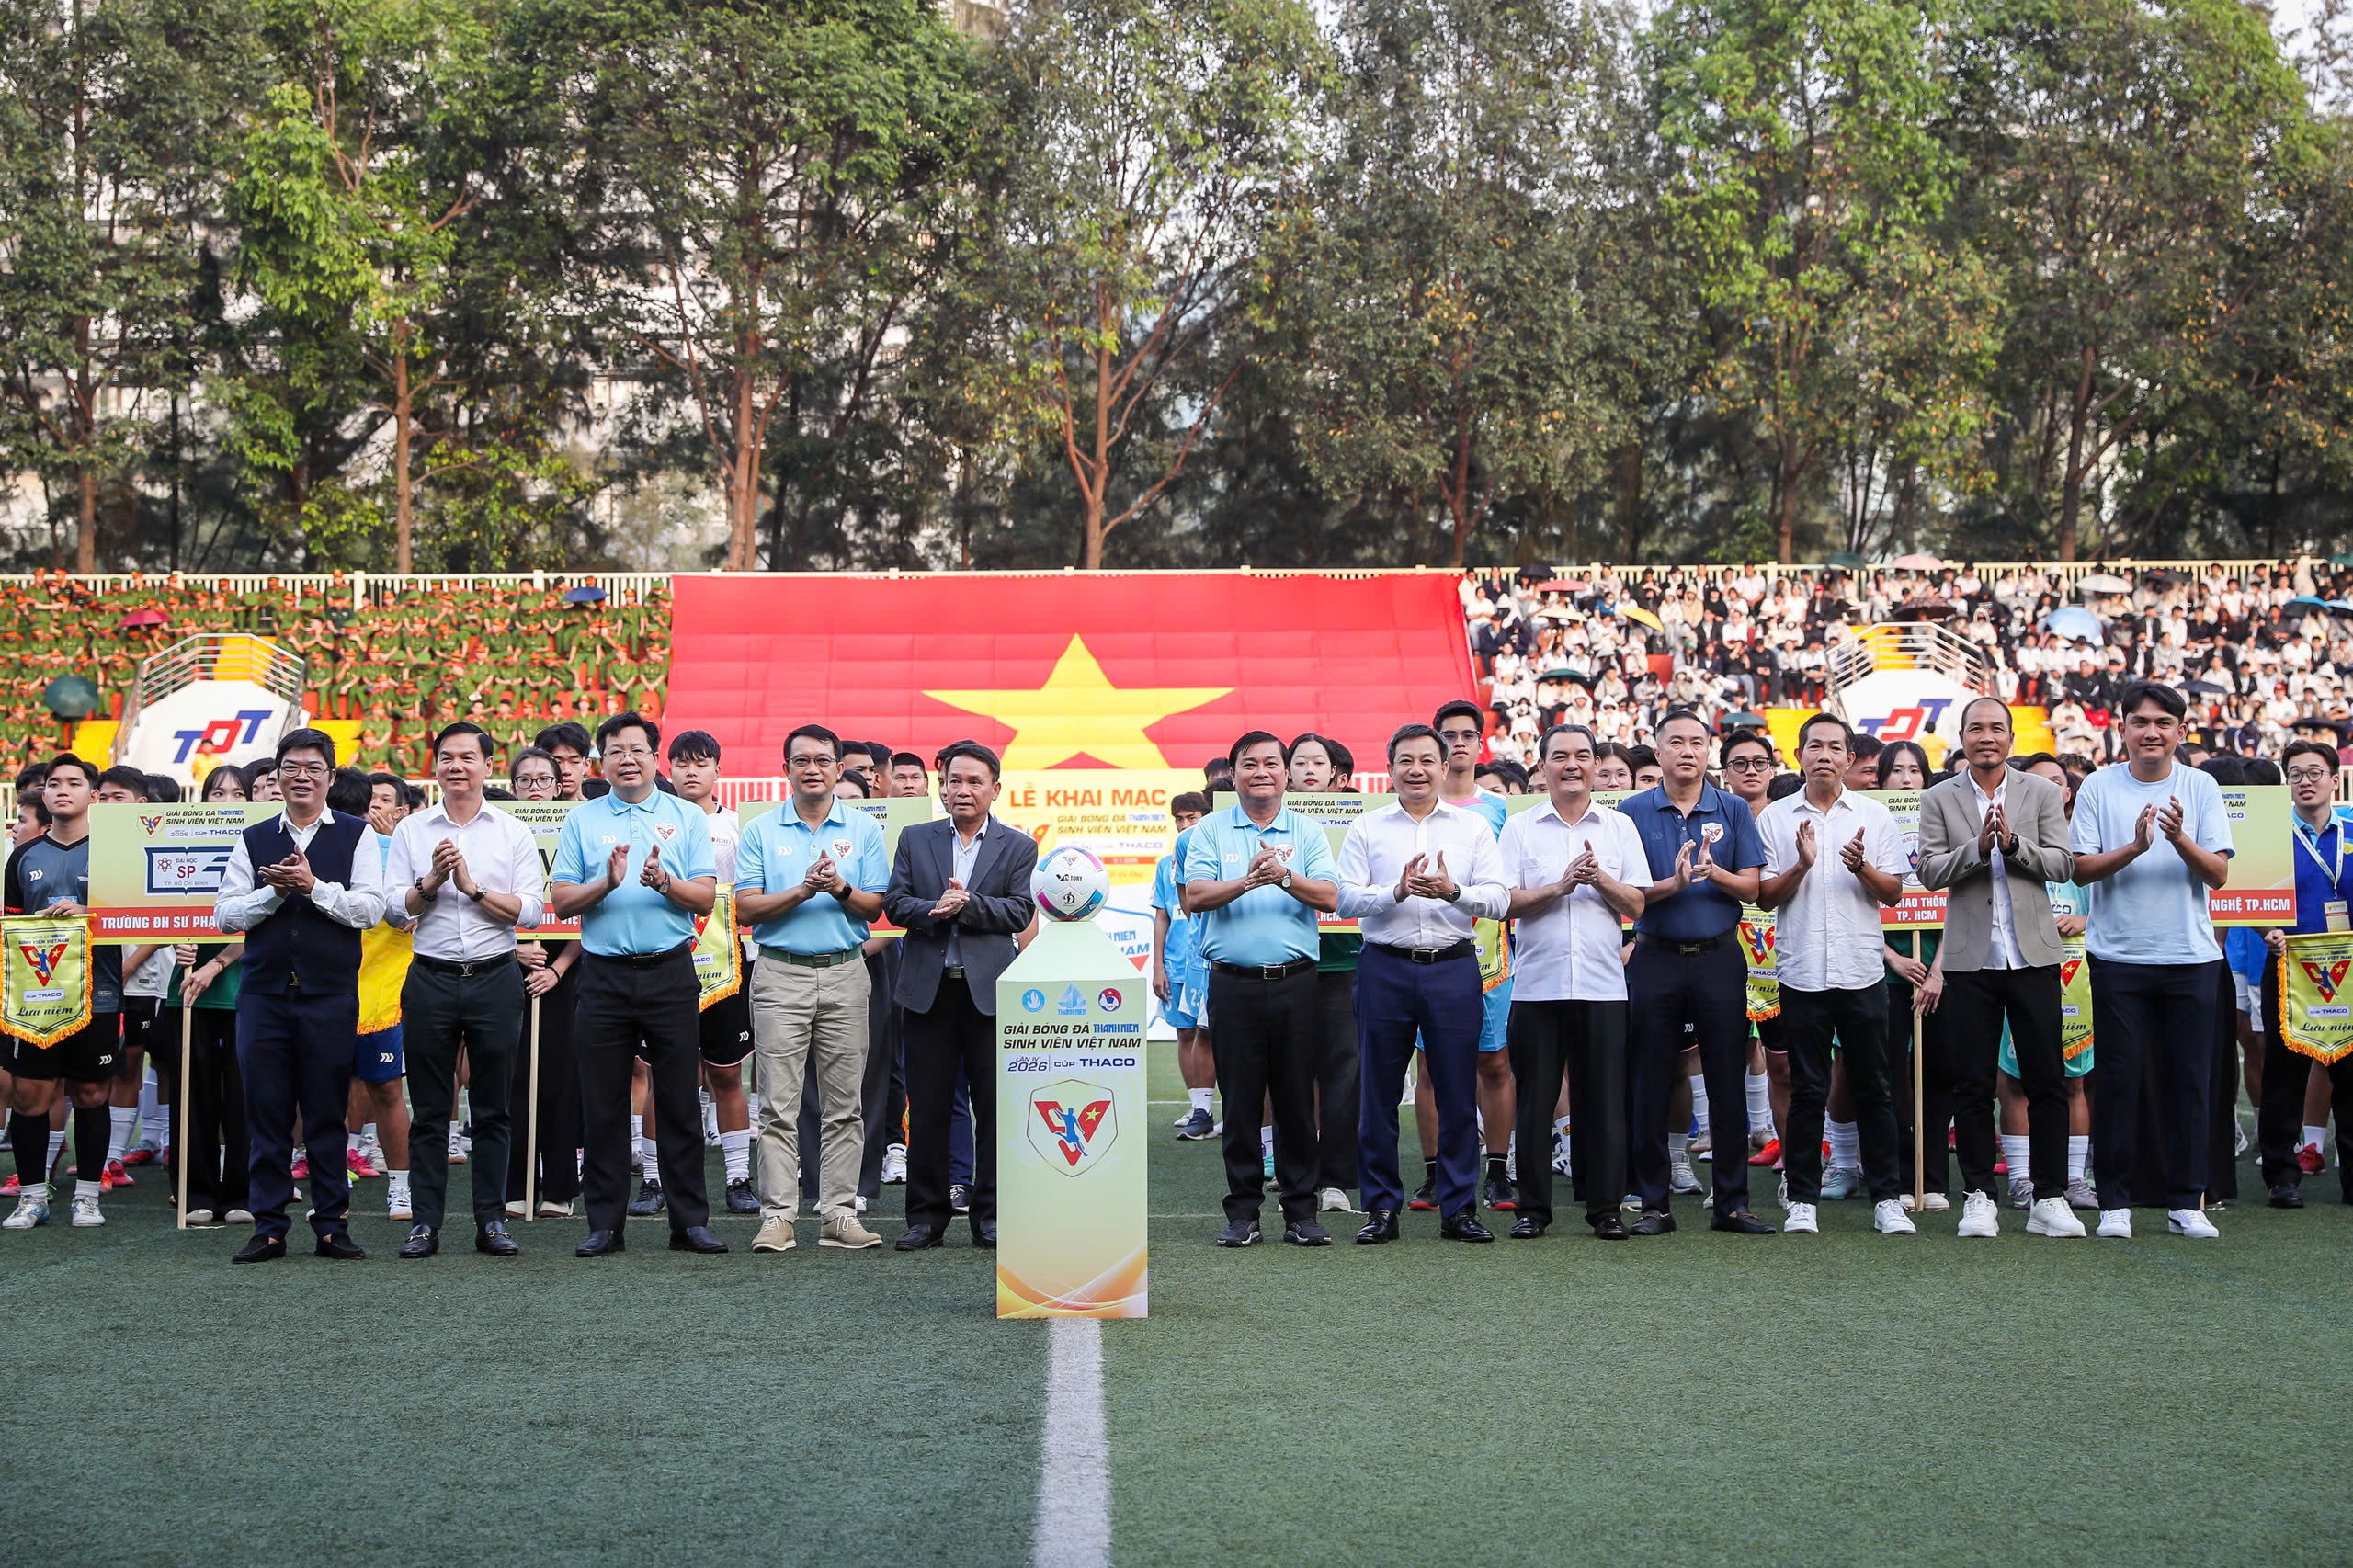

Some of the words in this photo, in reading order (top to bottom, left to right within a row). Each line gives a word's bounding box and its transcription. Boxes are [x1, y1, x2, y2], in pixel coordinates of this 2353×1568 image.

[1046, 790, 1102, 807] KHAI
[1111, 790, 1167, 810] MẠC
[1058, 825, 1084, 834] SINH
[1142, 824, 1167, 834] NAM
[177, 865, 196, 879] SP
[1920, 895, 1946, 907] THÔN
[2211, 896, 2243, 913] NGHỆ
[2245, 898, 2290, 911] TP.HCM
[101, 914, 150, 929] TRƯỜNG
[153, 916, 169, 928] ĐH
[173, 915, 190, 928] SƯ
[192, 915, 216, 930] PHẠ
[1896, 911, 1912, 921] TP.
[1915, 910, 1938, 920] HCM
[1004, 1022, 1029, 1035] GIẢI
[1032, 1022, 1069, 1035] BÓNG
[1072, 1022, 1090, 1034] ĐÁ
[1003, 1039, 1037, 1049] SINH
[1040, 1036, 1073, 1049] VIÊN
[1076, 1036, 1105, 1051] VIỆT
[1108, 1038, 1142, 1048] NAM
[1007, 1062, 1048, 1072] 2026
[1079, 1058, 1135, 1067] THACO
